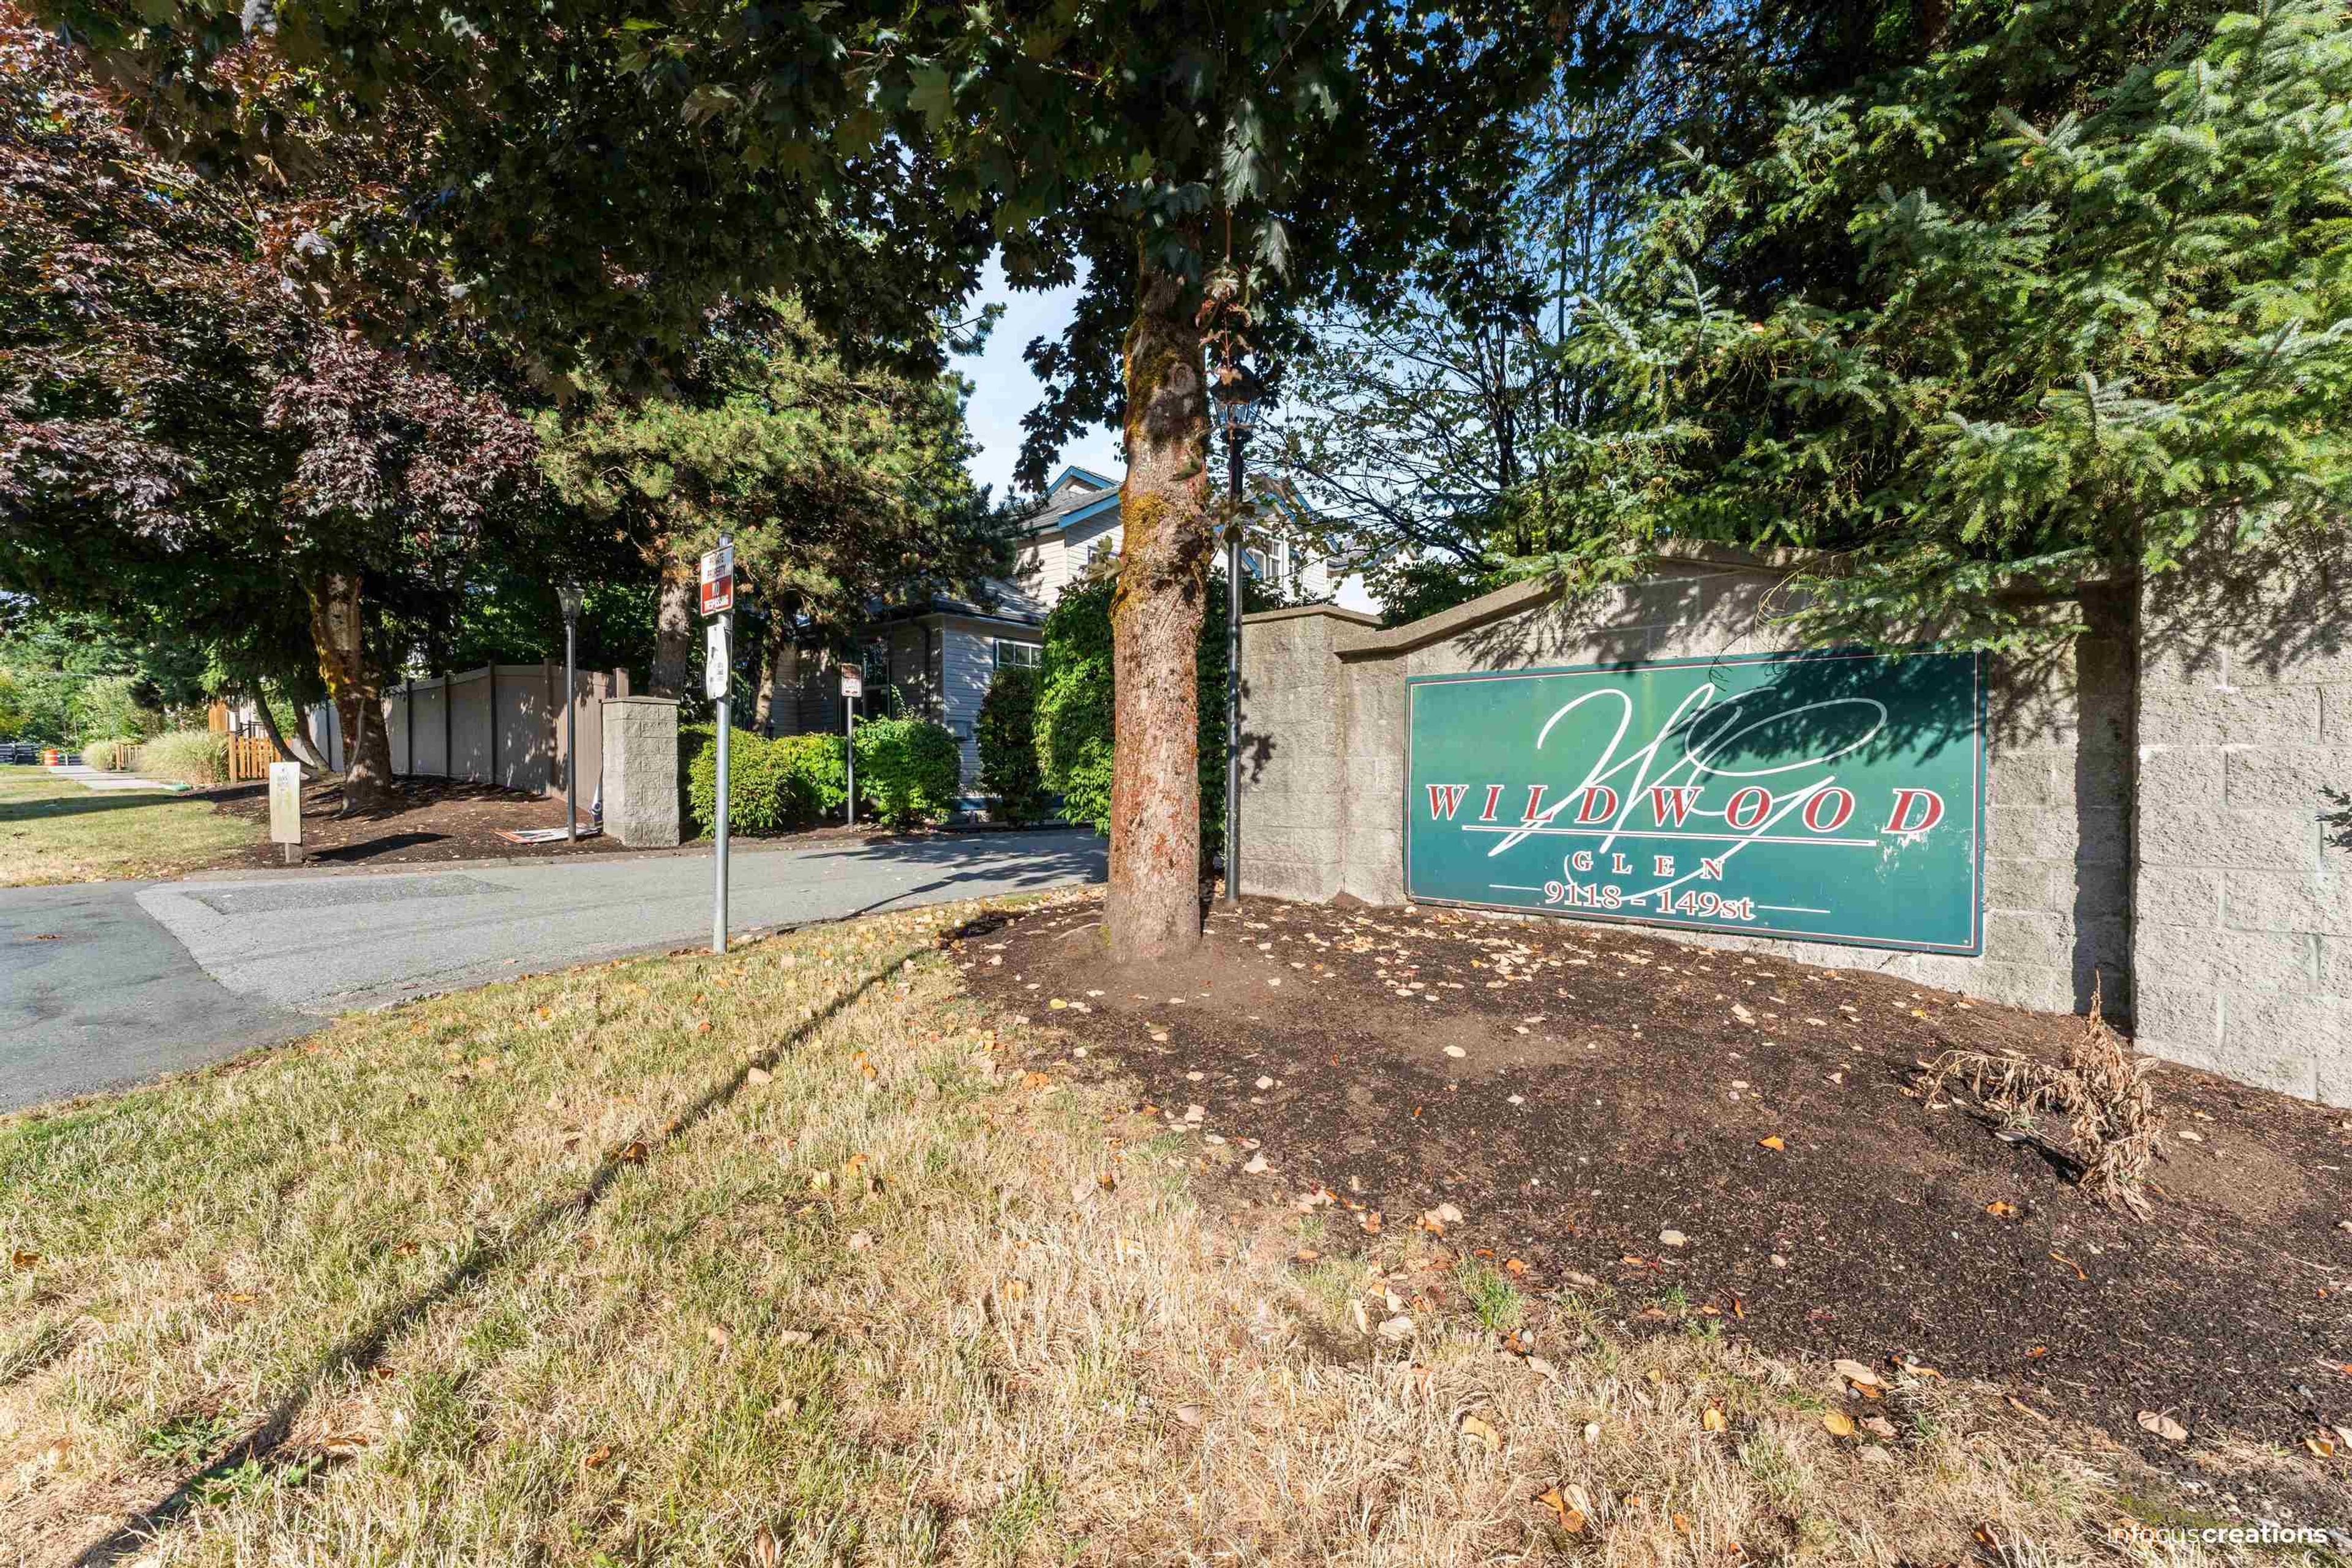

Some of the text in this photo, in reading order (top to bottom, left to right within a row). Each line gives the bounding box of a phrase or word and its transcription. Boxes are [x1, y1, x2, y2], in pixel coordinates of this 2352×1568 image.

[712, 581, 720, 598] NO
[1426, 783, 1945, 834] WILDWOOD
[1572, 851, 1725, 881] GLEN
[1544, 881, 1622, 910] 9118
[1656, 888, 1757, 920] 149st
